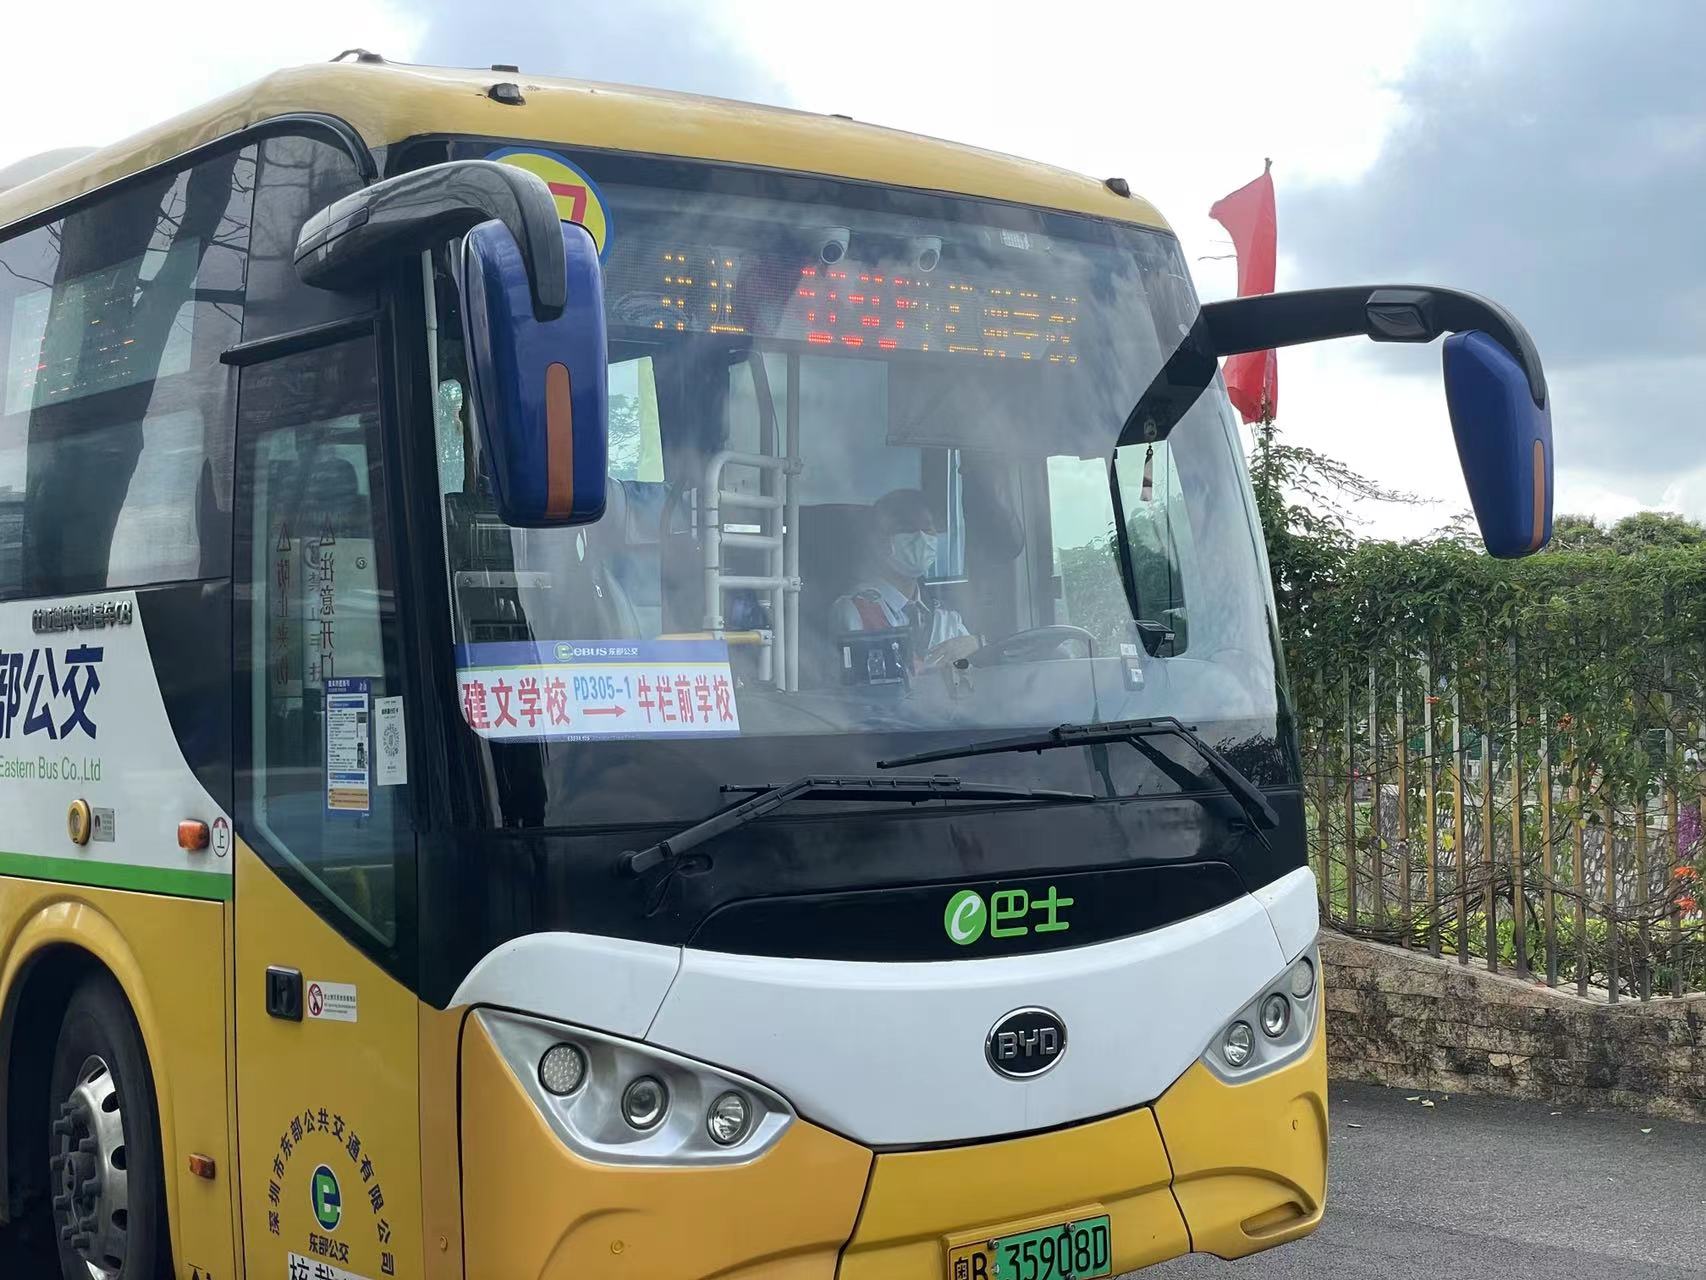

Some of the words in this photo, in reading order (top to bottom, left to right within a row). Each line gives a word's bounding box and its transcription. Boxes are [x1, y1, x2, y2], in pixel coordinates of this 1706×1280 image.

[462, 676, 571, 730] 建文学校
[637, 673, 734, 724] 牛栏前学校
[573, 675, 632, 701] PD305-1
[38, 756, 58, 780] Bus
[998, 1027, 1058, 1060] BYD
[268, 1107, 395, 1276] 深圳市东部公共交通有限公司
[308, 1231, 350, 1264] 东部公交
